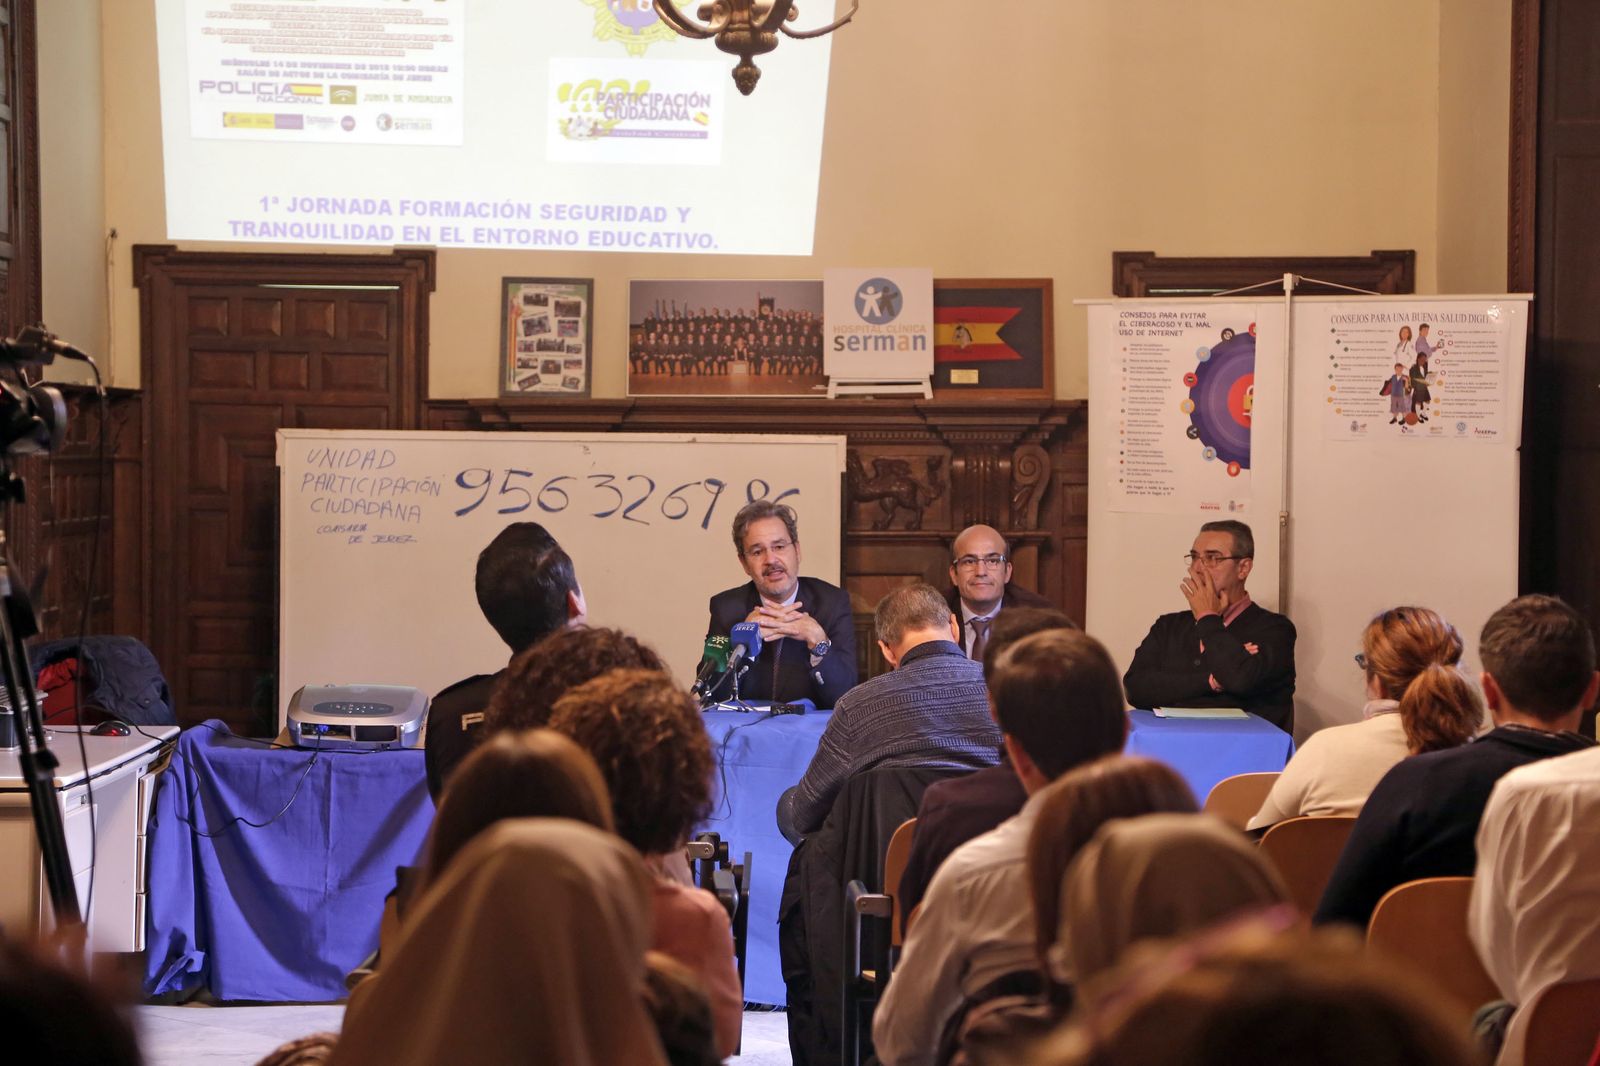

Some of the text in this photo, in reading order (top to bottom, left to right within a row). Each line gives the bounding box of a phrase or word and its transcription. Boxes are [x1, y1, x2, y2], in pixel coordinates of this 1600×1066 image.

[256, 95, 323, 105] NACIONAL
[596, 92, 711, 108] PARTICIPACIÓN
[603, 106, 690, 121] CIUDADANA
[287, 197, 393, 216] JORNADA
[400, 199, 531, 220] FORMACIÓN
[540, 203, 668, 223] SEGURIDAD
[677, 206, 692, 224] Y
[228, 219, 719, 249] TRANQUILIDAD EN EL ENTORNO EDUCATIVO.
[1119, 311, 1157, 319] CONSEJOS
[1330, 314, 1370, 324] CONSEJOS
[1370, 313, 1392, 323] PARA
[1393, 313, 1411, 323] UNA
[1411, 312, 1439, 323] BUENA
[1440, 313, 1468, 323] SALUD
[833, 324, 883, 334] HOSPITAL
[1130, 320, 1176, 328] CIBERACOSO
[1148, 329, 1184, 337] INTERNET
[833, 334, 927, 352] serman
[306, 448, 397, 470] UNIDAD
[300, 472, 442, 497] PARTICIPACIÓN
[310, 498, 421, 524] CIUDADANA
[347, 534, 417, 545] DE JEREZ
